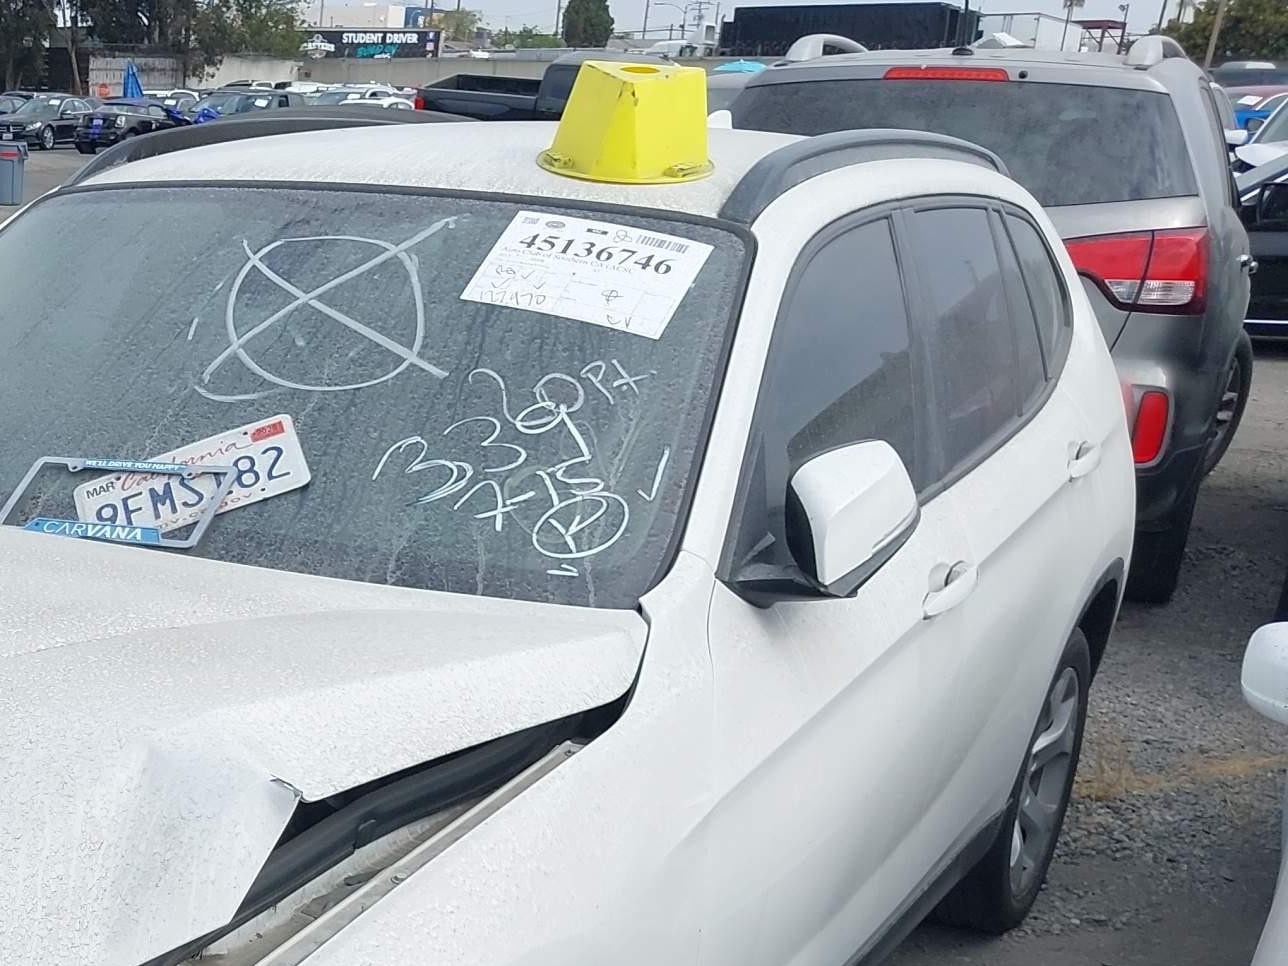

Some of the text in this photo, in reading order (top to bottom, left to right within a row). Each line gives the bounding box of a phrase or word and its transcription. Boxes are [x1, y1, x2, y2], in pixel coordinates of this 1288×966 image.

[342, 33, 418, 44] STUDENT DRIVER
[519, 232, 677, 275] 45136746
[86, 481, 115, 499] MAR
[43, 520, 142, 541] CARVANA
